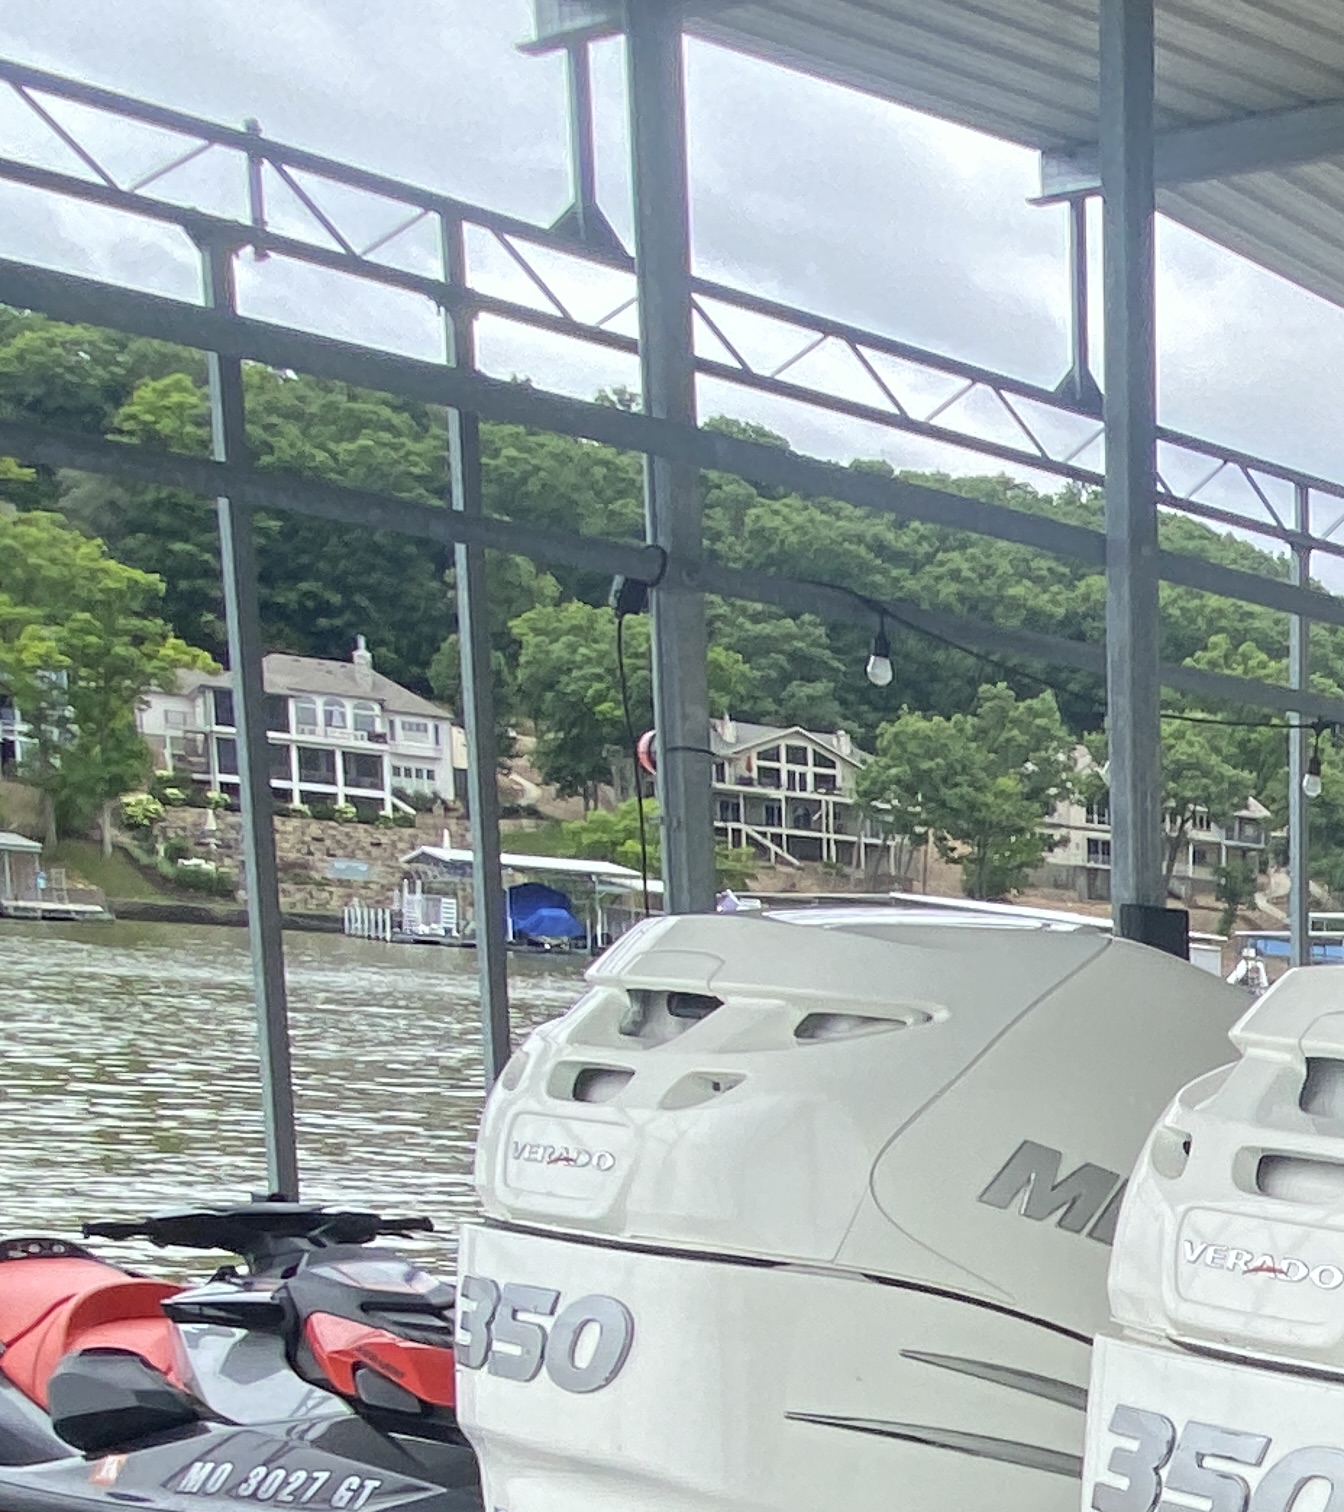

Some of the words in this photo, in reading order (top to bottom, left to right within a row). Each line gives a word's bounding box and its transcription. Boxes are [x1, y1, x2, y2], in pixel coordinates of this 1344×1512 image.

[512, 1140, 616, 1173] VERADO
[454, 1275, 636, 1395] 350
[174, 1461, 235, 1496] MO
[236, 1464, 332, 1505] 3027
[329, 1474, 382, 1512] GT
